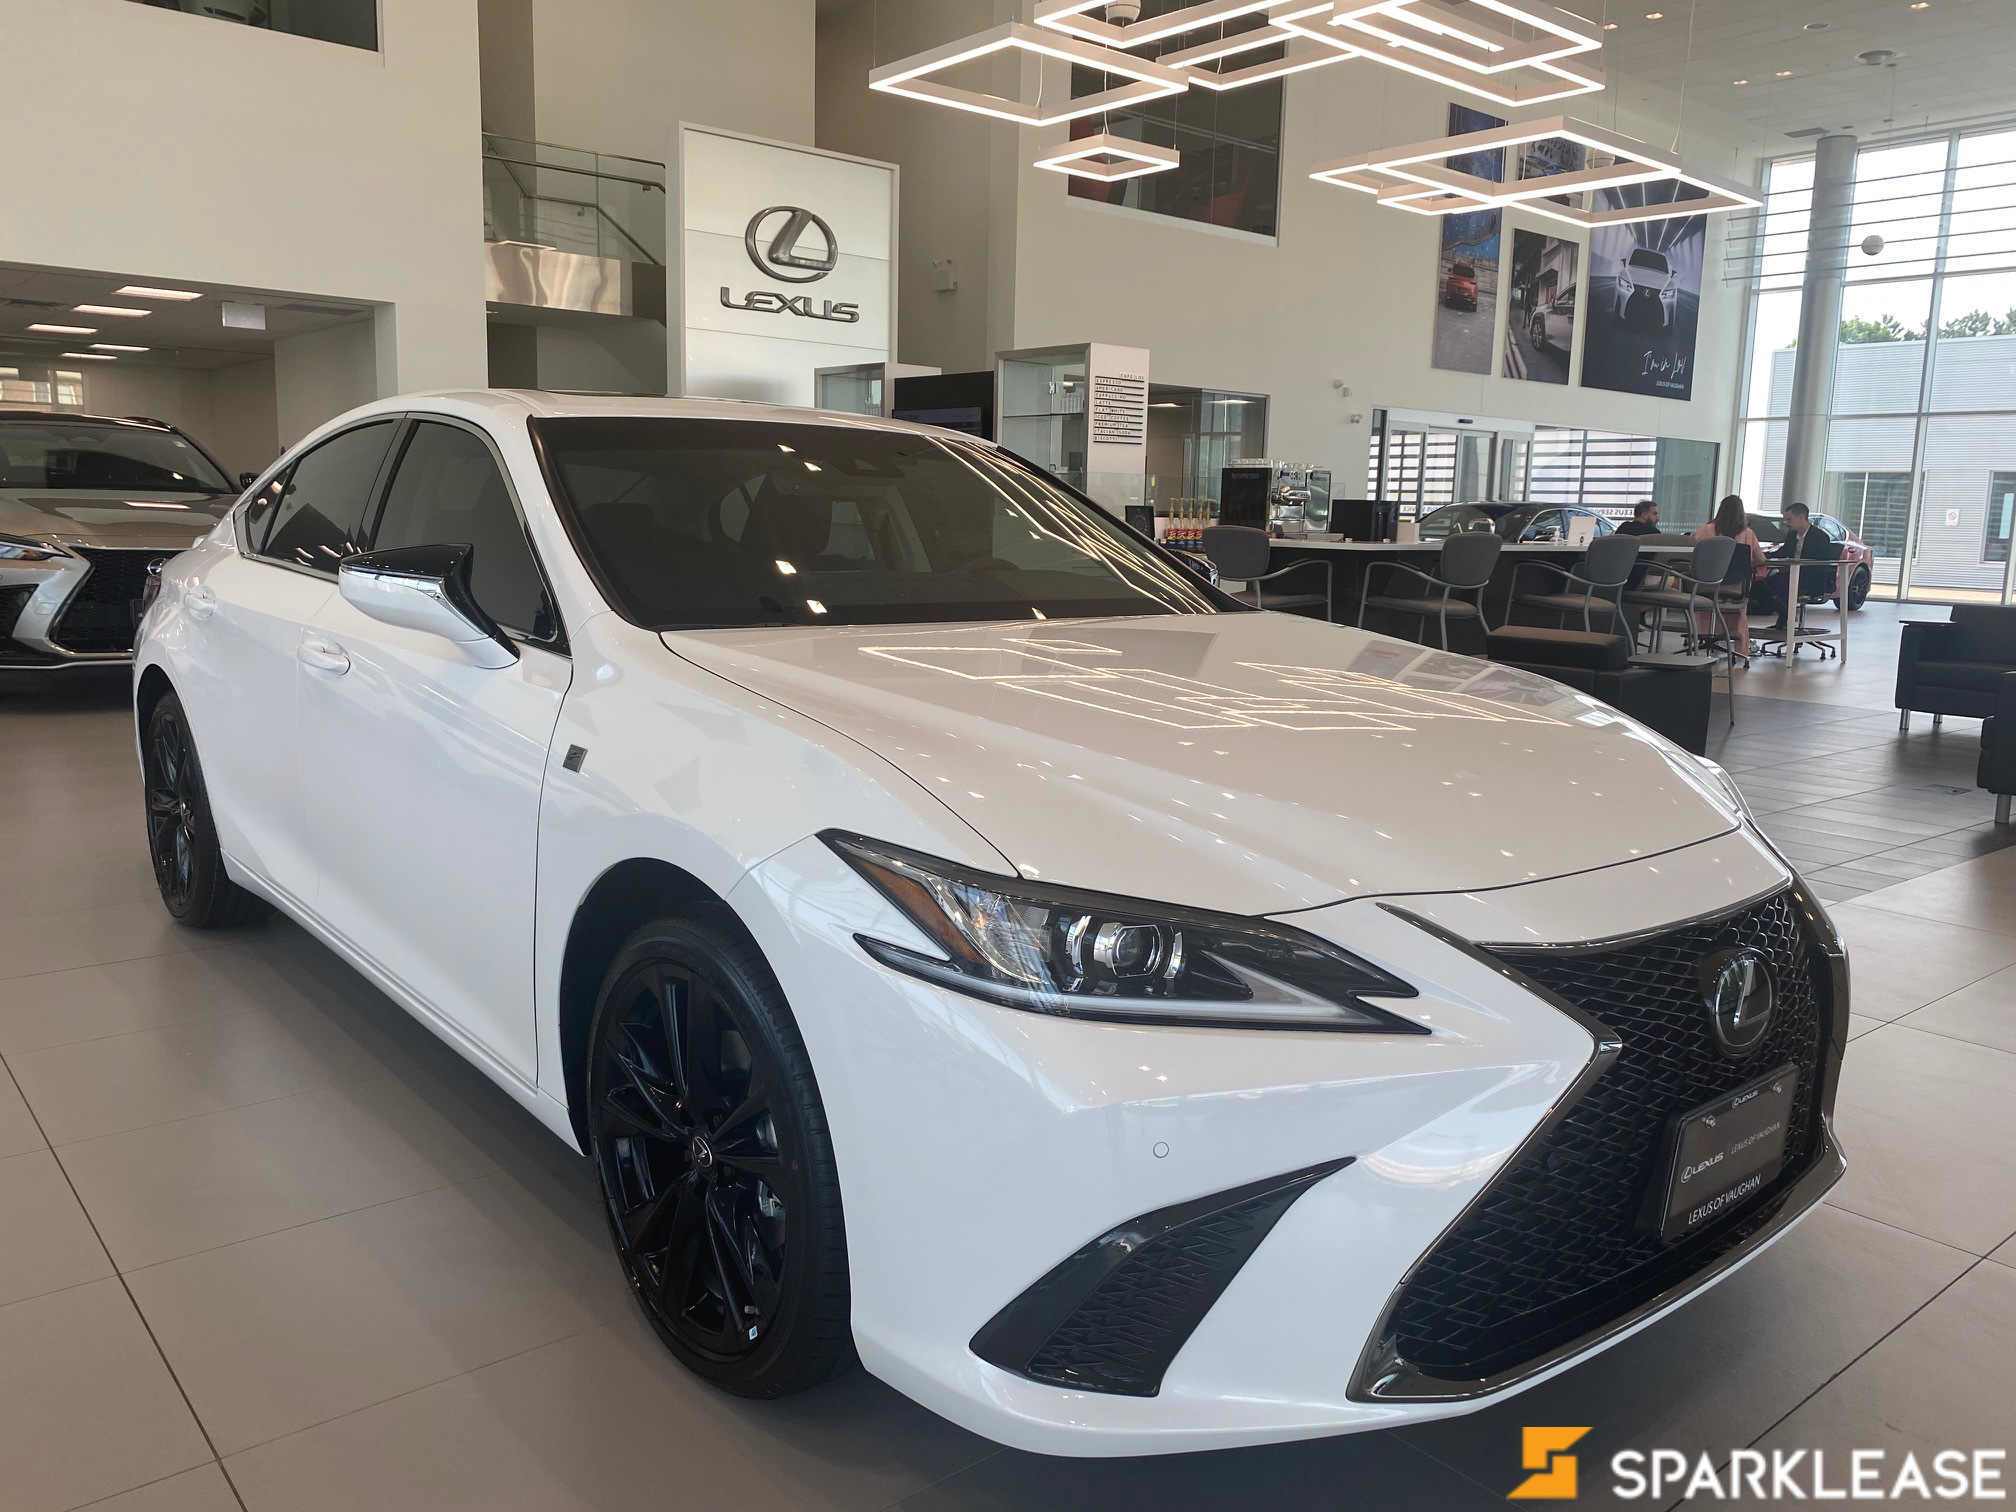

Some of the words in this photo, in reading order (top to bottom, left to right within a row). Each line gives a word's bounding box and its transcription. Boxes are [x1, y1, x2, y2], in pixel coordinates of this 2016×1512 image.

[721, 286, 860, 323] LEXUS
[1692, 1151, 1725, 1175] LEXUS
[1688, 1199, 1714, 1225] LEXUS
[1713, 1193, 1726, 1209] OF
[1725, 1174, 1762, 1203] VAUGHAN
